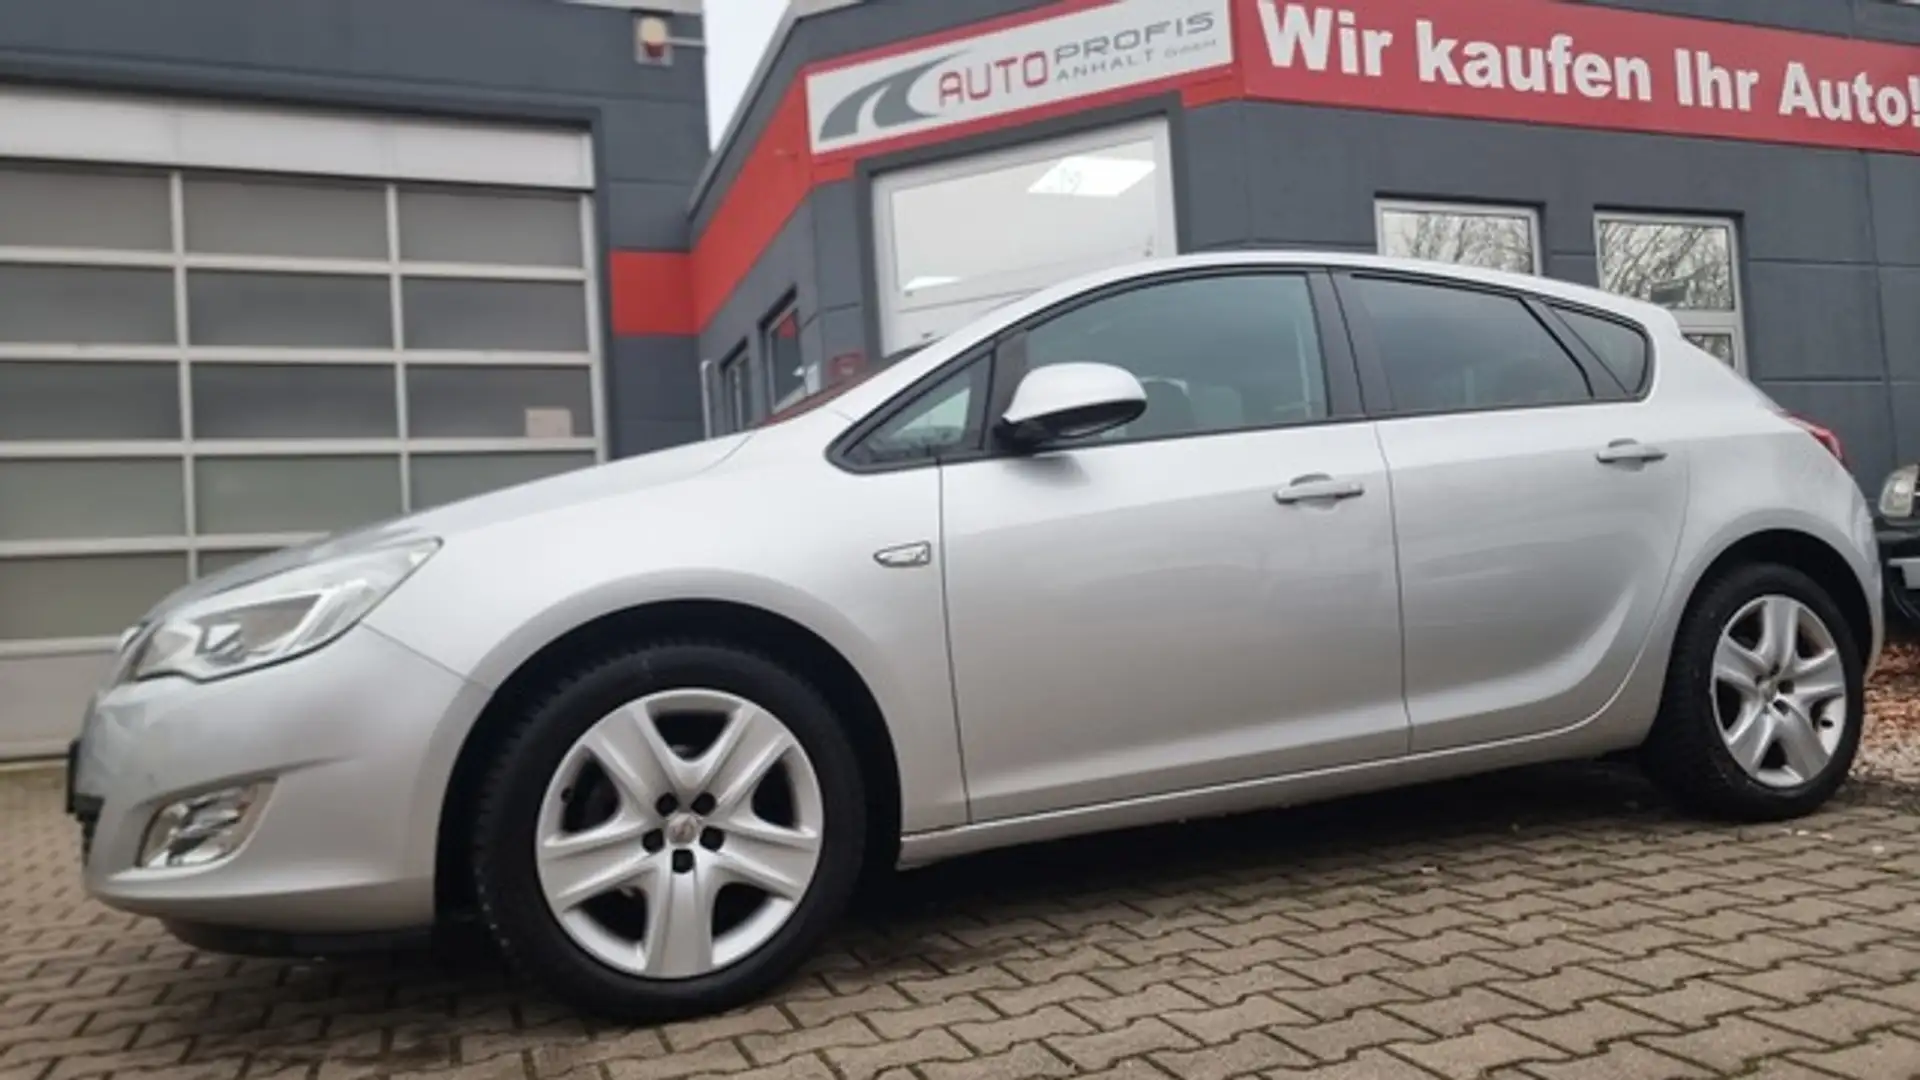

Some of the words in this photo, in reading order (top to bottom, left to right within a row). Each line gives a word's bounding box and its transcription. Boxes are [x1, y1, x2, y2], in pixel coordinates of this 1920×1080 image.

[1054, 11, 1214, 64] PROFIS
[1257, 0, 1393, 77] Wir
[1416, 19, 1652, 101] kaufen
[1675, 48, 1760, 111] Ihr
[1779, 61, 1920, 127] Auto!
[1056, 48, 1153, 82] ANHALT
